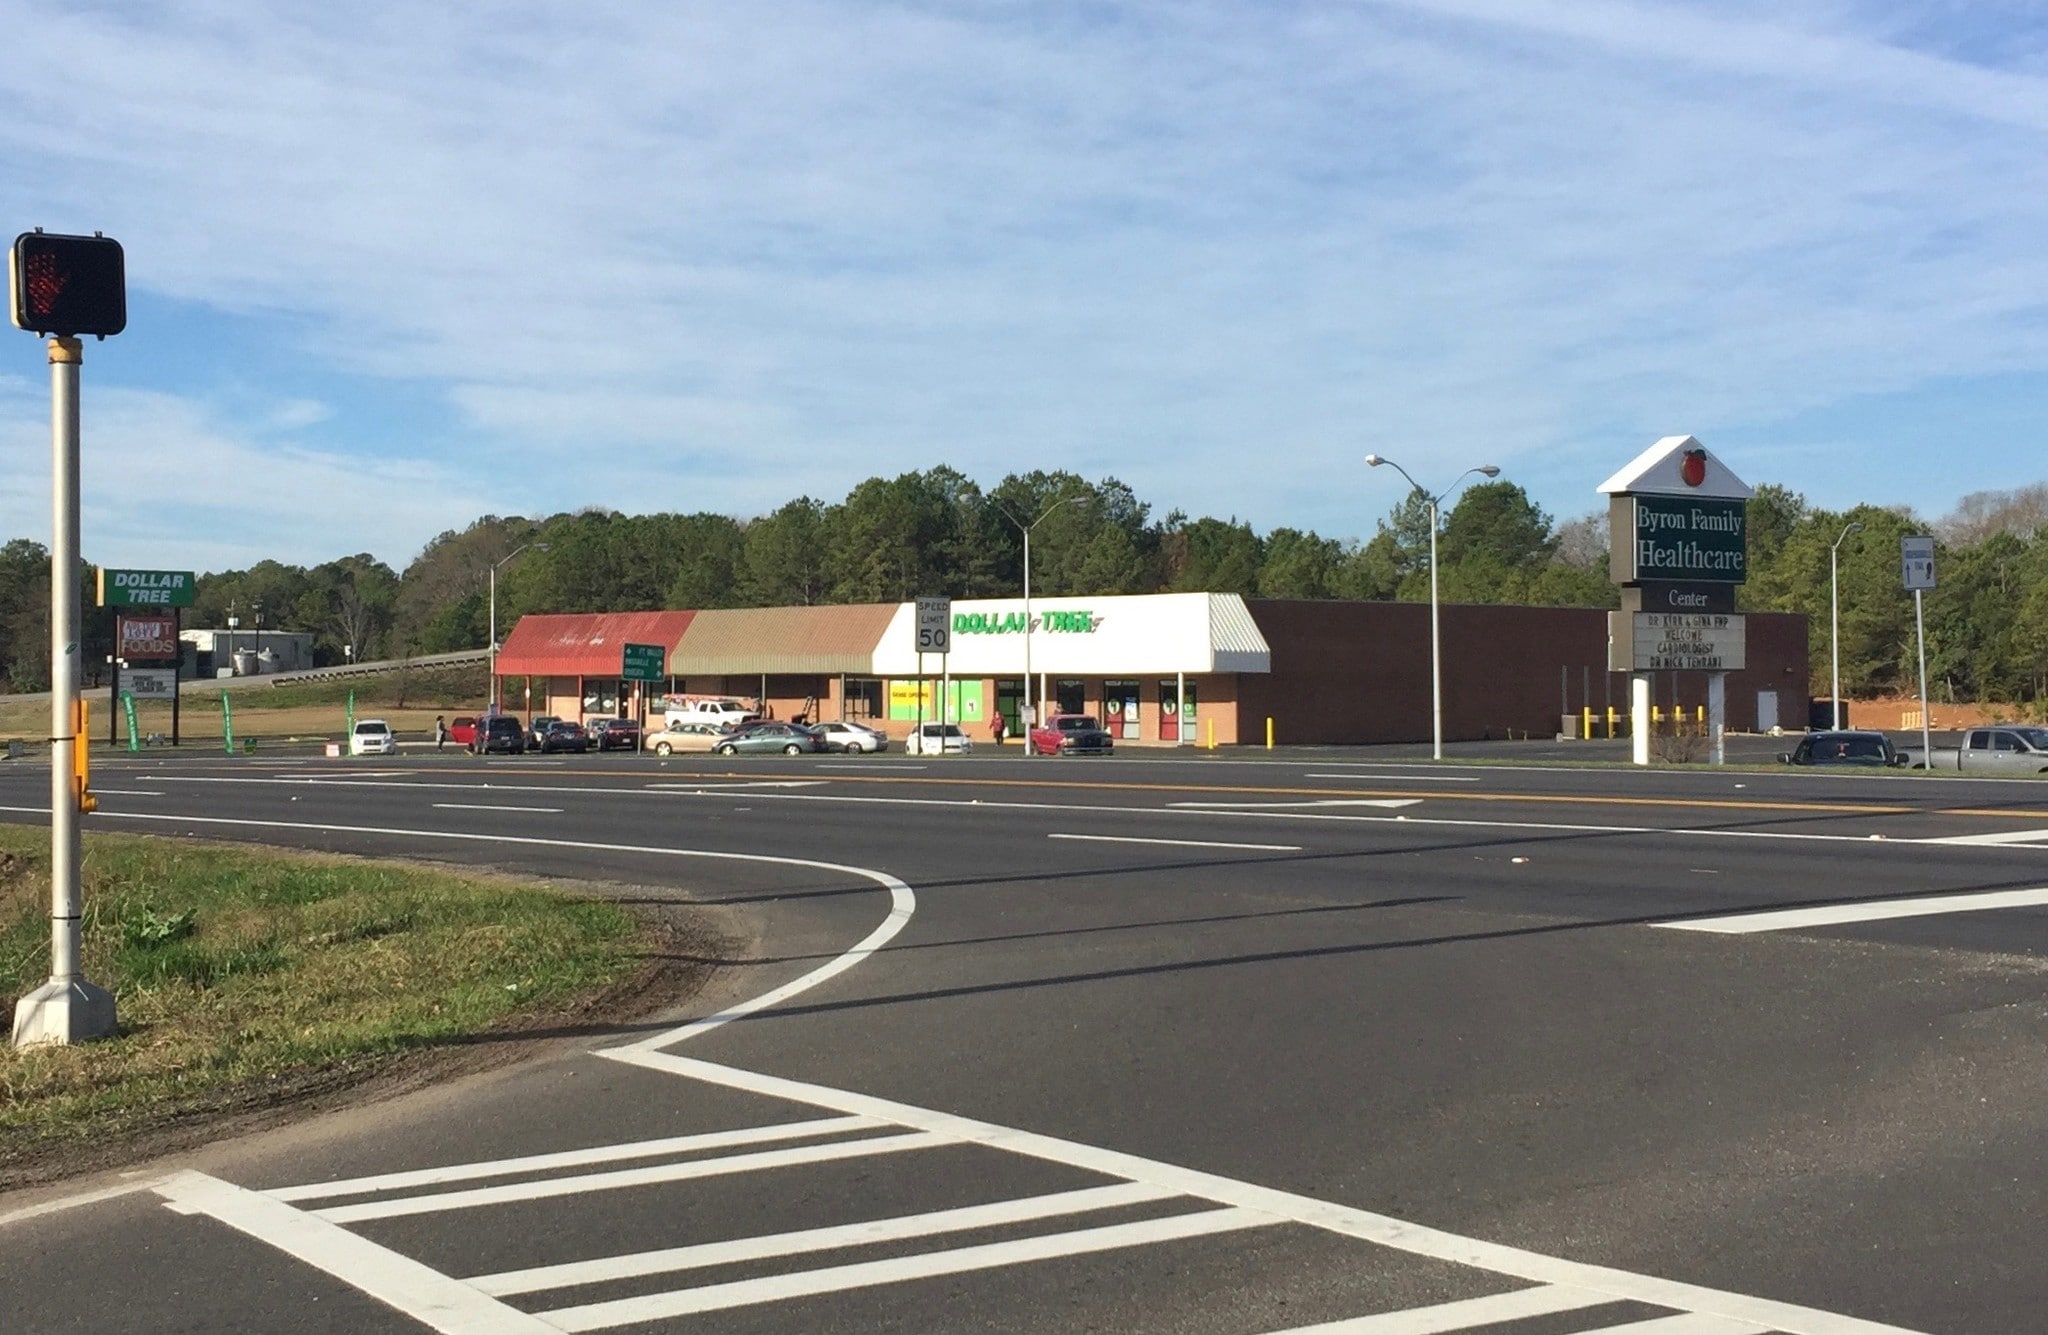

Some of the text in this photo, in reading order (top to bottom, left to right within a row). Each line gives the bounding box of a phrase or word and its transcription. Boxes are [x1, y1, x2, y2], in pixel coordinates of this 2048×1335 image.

[1638, 505, 1742, 536] Byron Family
[1638, 539, 1743, 570] Healthcare
[114, 573, 185, 588] DOLLAR
[127, 589, 172, 603] TREE
[1668, 589, 1708, 607] Center
[918, 601, 948, 611] SPEED
[921, 616, 944, 624] LIMIT
[1041, 610, 1093, 631] TREE
[1648, 615, 1659, 626] DR
[919, 629, 946, 647] 50
[1665, 629, 1703, 641] WELCOME
[121, 639, 175, 654] FOODS
[1657, 642, 1714, 655] CARDIOLOGIST
[1650, 656, 1661, 668] DR
[1664, 656, 1684, 668] NICK
